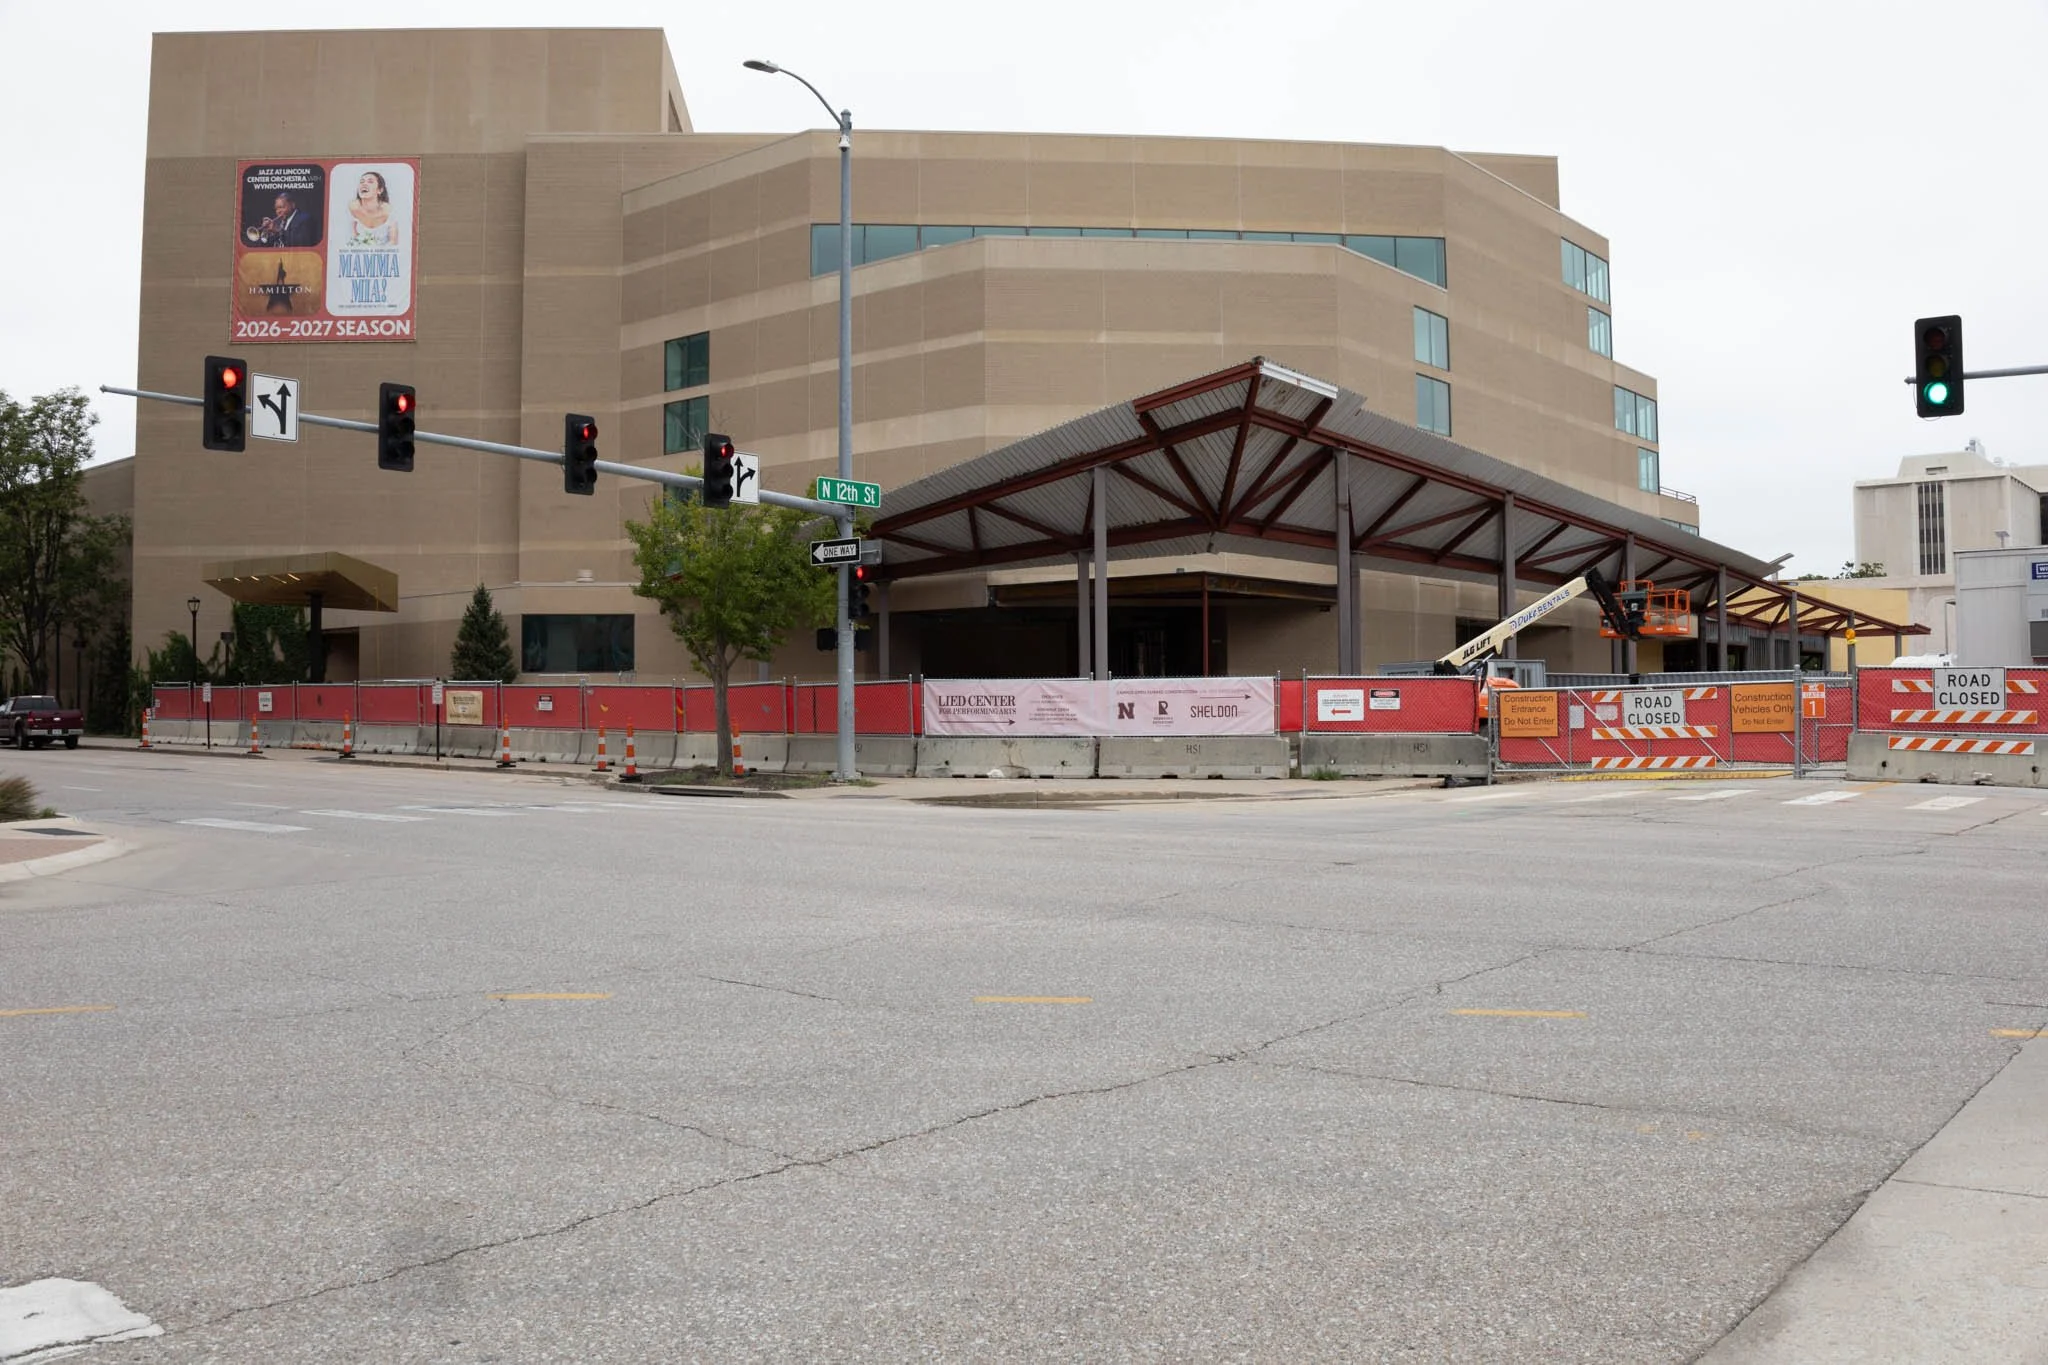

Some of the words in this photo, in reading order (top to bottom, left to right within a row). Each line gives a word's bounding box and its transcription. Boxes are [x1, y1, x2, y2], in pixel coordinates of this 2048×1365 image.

[338, 254, 400, 278] MAMMA
[249, 286, 312, 294] HAMILTON
[351, 279, 387, 303] MIA!
[336, 320, 410, 336] SEASON
[822, 480, 831, 498] N
[836, 483, 858, 502] 12th
[864, 486, 875, 504] St
[824, 546, 838, 557] ONE
[840, 544, 856, 556] WAY
[1538, 589, 1570, 613] RENTALS
[1462, 646, 1475, 660] JLG
[1476, 636, 1491, 652] LIFT
[1948, 674, 1990, 687] ROAD
[938, 695, 968, 707] LIED
[968, 695, 1016, 707] CENTER
[1635, 696, 1672, 708] ROAD
[1735, 693, 1792, 702] Construction
[1939, 692, 2000, 705] CLOSED
[1117, 702, 1135, 719] N
[1190, 705, 1238, 718] SHELDON
[1732, 706, 1770, 714] Vehicles
[1773, 704, 1795, 715] Only
[1809, 700, 1816, 717] 1
[1628, 712, 1680, 725] CLOSED
